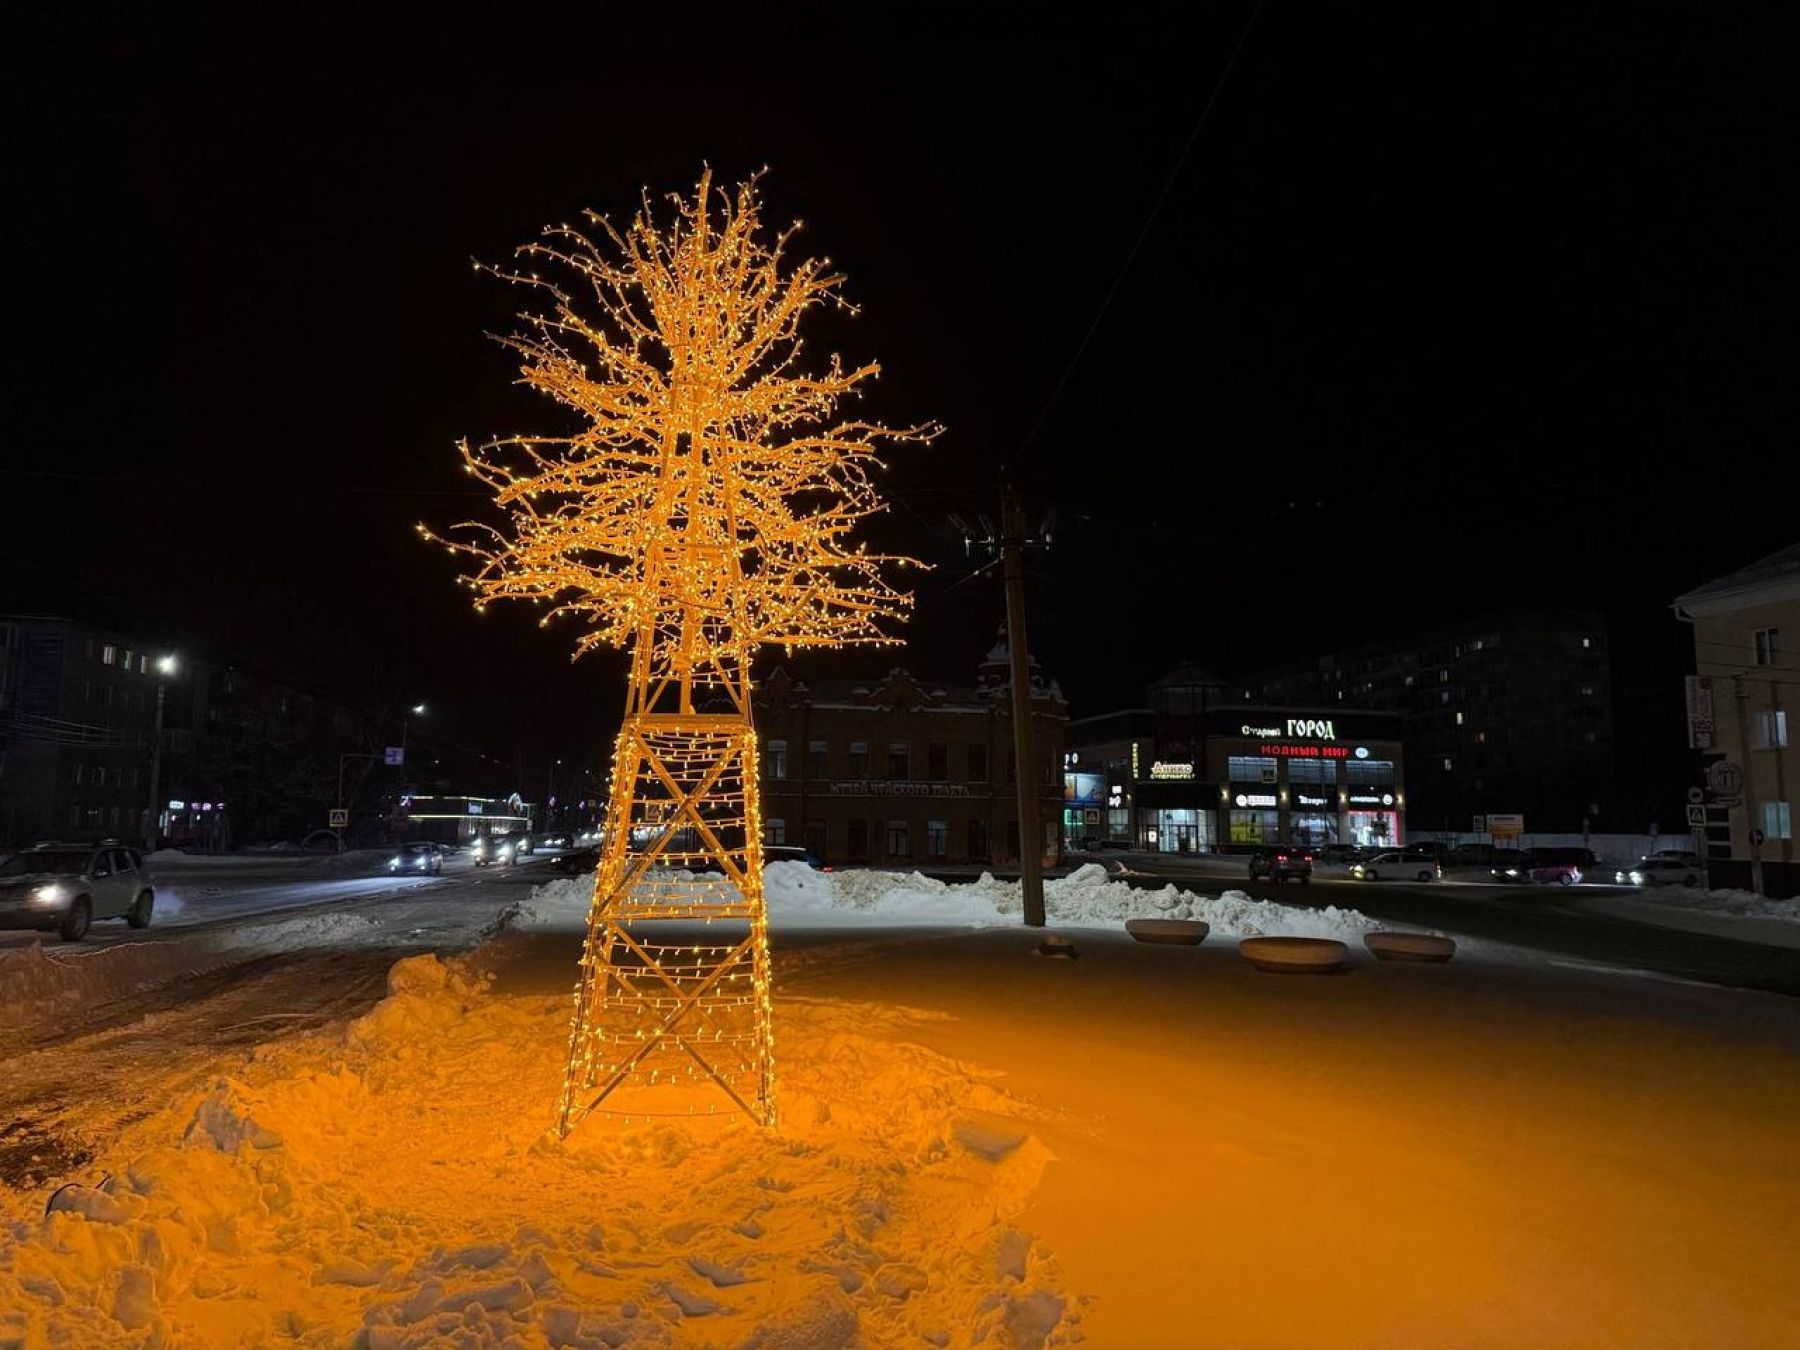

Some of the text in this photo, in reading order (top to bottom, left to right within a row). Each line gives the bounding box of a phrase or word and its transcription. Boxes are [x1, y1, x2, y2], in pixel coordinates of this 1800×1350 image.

[1287, 719, 1335, 741] ГОРОД
[1261, 745, 1350, 757] МОДНЫЙ МИР
